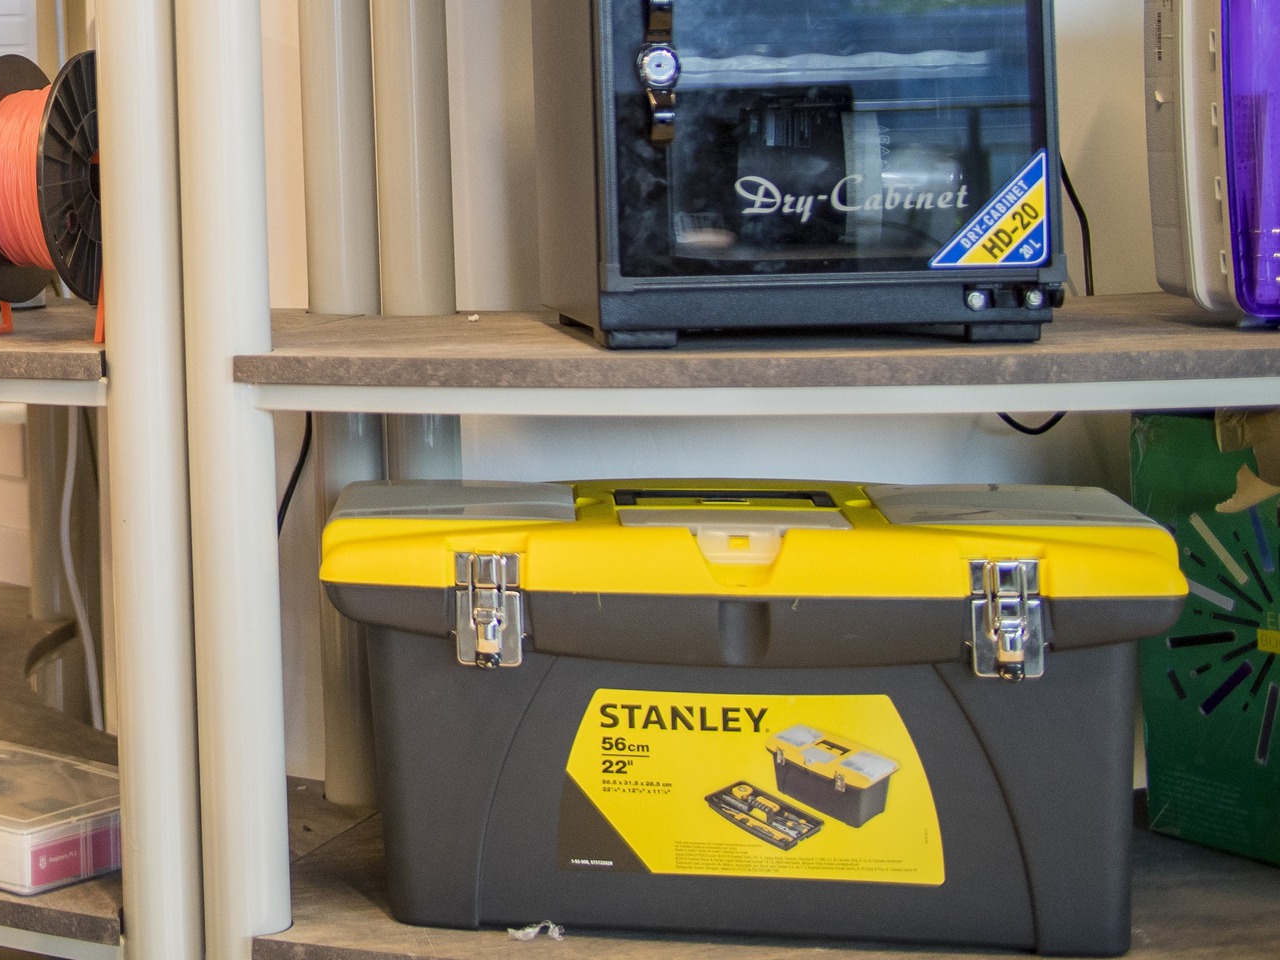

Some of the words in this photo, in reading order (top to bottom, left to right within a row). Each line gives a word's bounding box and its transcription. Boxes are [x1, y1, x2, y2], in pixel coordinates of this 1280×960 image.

[734, 173, 969, 223] Dry-Cabinet
[959, 179, 1029, 249] DRY-CABINET
[981, 201, 1039, 259] HD-20
[1019, 244, 1035, 259] 20
[1028, 238, 1042, 249] L
[599, 703, 768, 733] STANLEY
[601, 759, 633, 774] 22"
